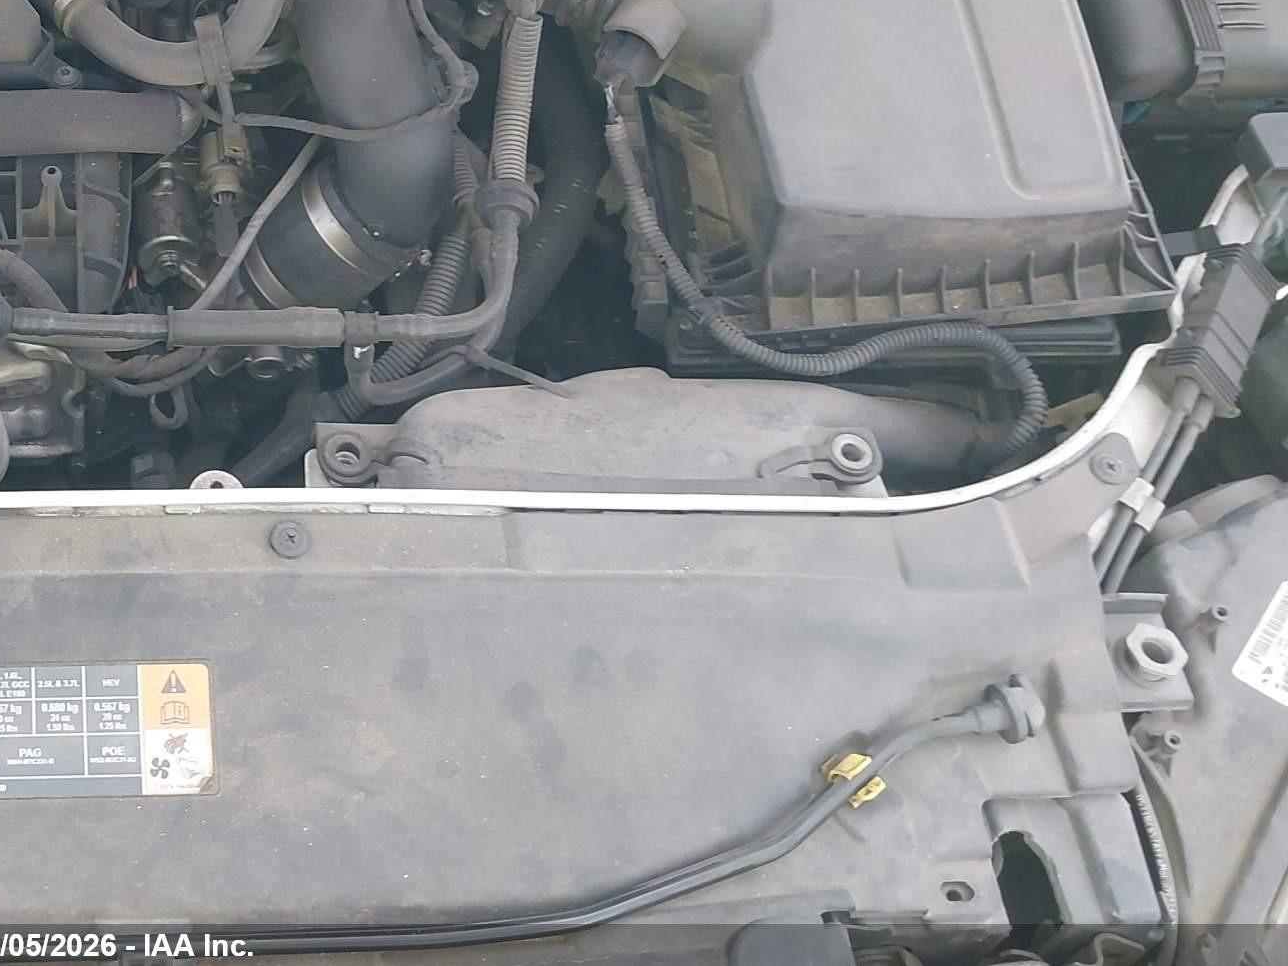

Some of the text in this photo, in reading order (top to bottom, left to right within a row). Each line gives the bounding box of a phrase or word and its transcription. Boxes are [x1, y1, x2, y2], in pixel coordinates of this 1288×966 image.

[9, 704, 22, 716] kg
[66, 703, 79, 715] kg
[118, 702, 131, 714] kg
[19, 747, 42, 758] PAG
[102, 746, 126, 756] POE
